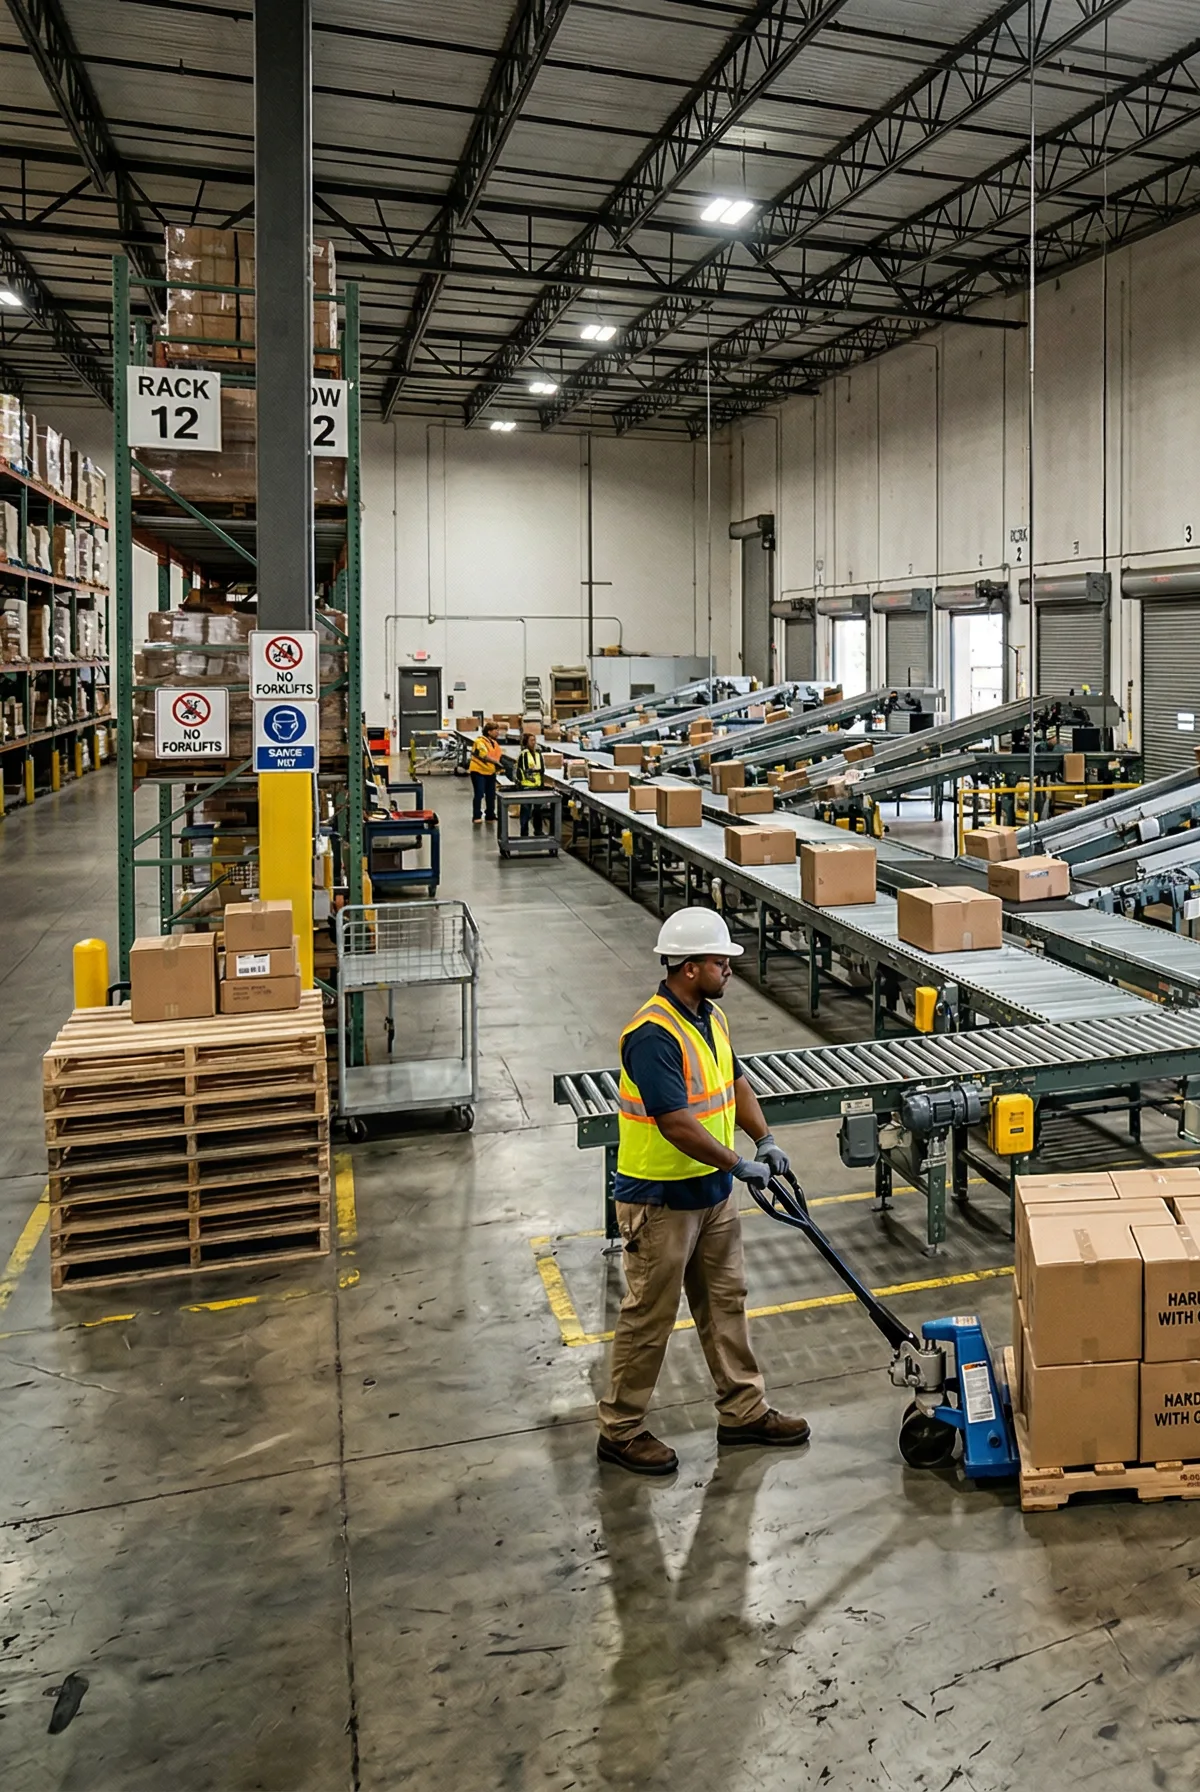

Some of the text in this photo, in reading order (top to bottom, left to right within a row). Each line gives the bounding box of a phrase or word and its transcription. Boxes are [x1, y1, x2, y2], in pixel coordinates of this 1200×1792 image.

[138, 375, 211, 400] RACK
[151, 405, 199, 440] 12
[1185, 525, 1192, 543] 3
[276, 672, 293, 682] NO
[183, 729, 201, 740] NO
[1158, 1310, 1194, 1326] WITH
[1154, 1410, 1190, 1427] WITH
